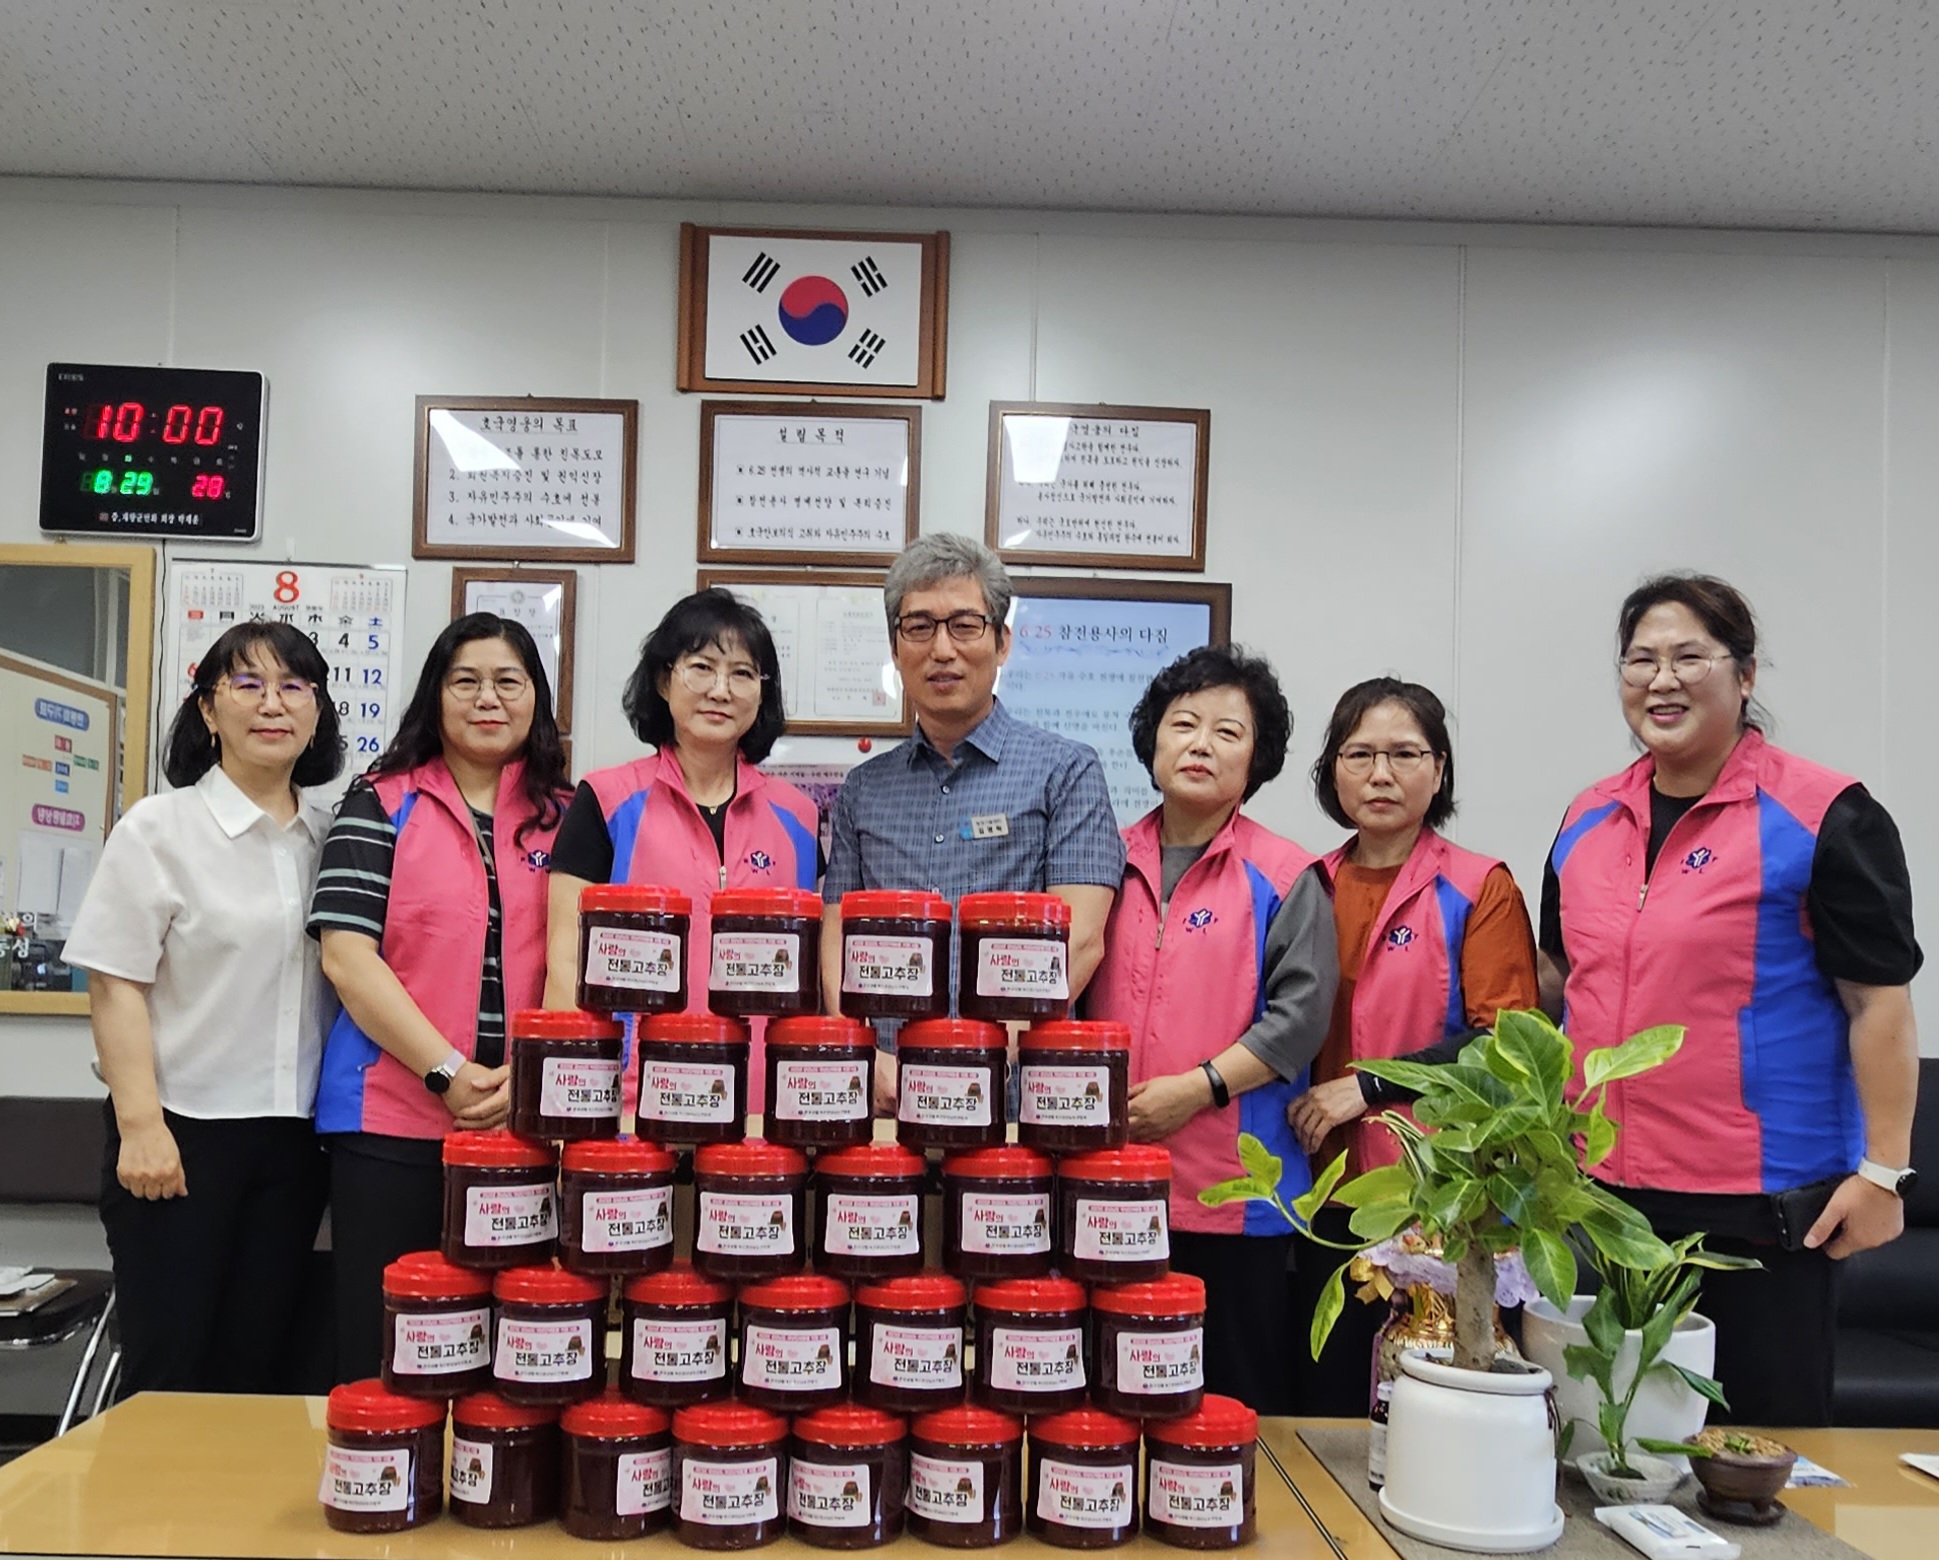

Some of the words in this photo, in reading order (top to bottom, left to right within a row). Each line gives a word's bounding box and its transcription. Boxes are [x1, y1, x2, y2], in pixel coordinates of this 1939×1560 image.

[97, 402, 224, 445] 10:00
[553, 417, 578, 432] 목표
[191, 474, 224, 497] 28
[448, 492, 459, 503] 3.
[467, 491, 532, 505] 자유민주주의
[540, 492, 572, 505] 수호에
[466, 512, 518, 528] 국가발전과
[273, 570, 300, 603] 8
[368, 617, 383, 626] 土
[338, 633, 350, 648] 4
[368, 635, 379, 650] 5
[1059, 624, 1132, 643] 참전용사의
[1139, 627, 1168, 644] 다짐
[334, 667, 351, 682] 11
[363, 669, 382, 684] 12
[360, 703, 380, 718] 19
[357, 737, 380, 752] 26
